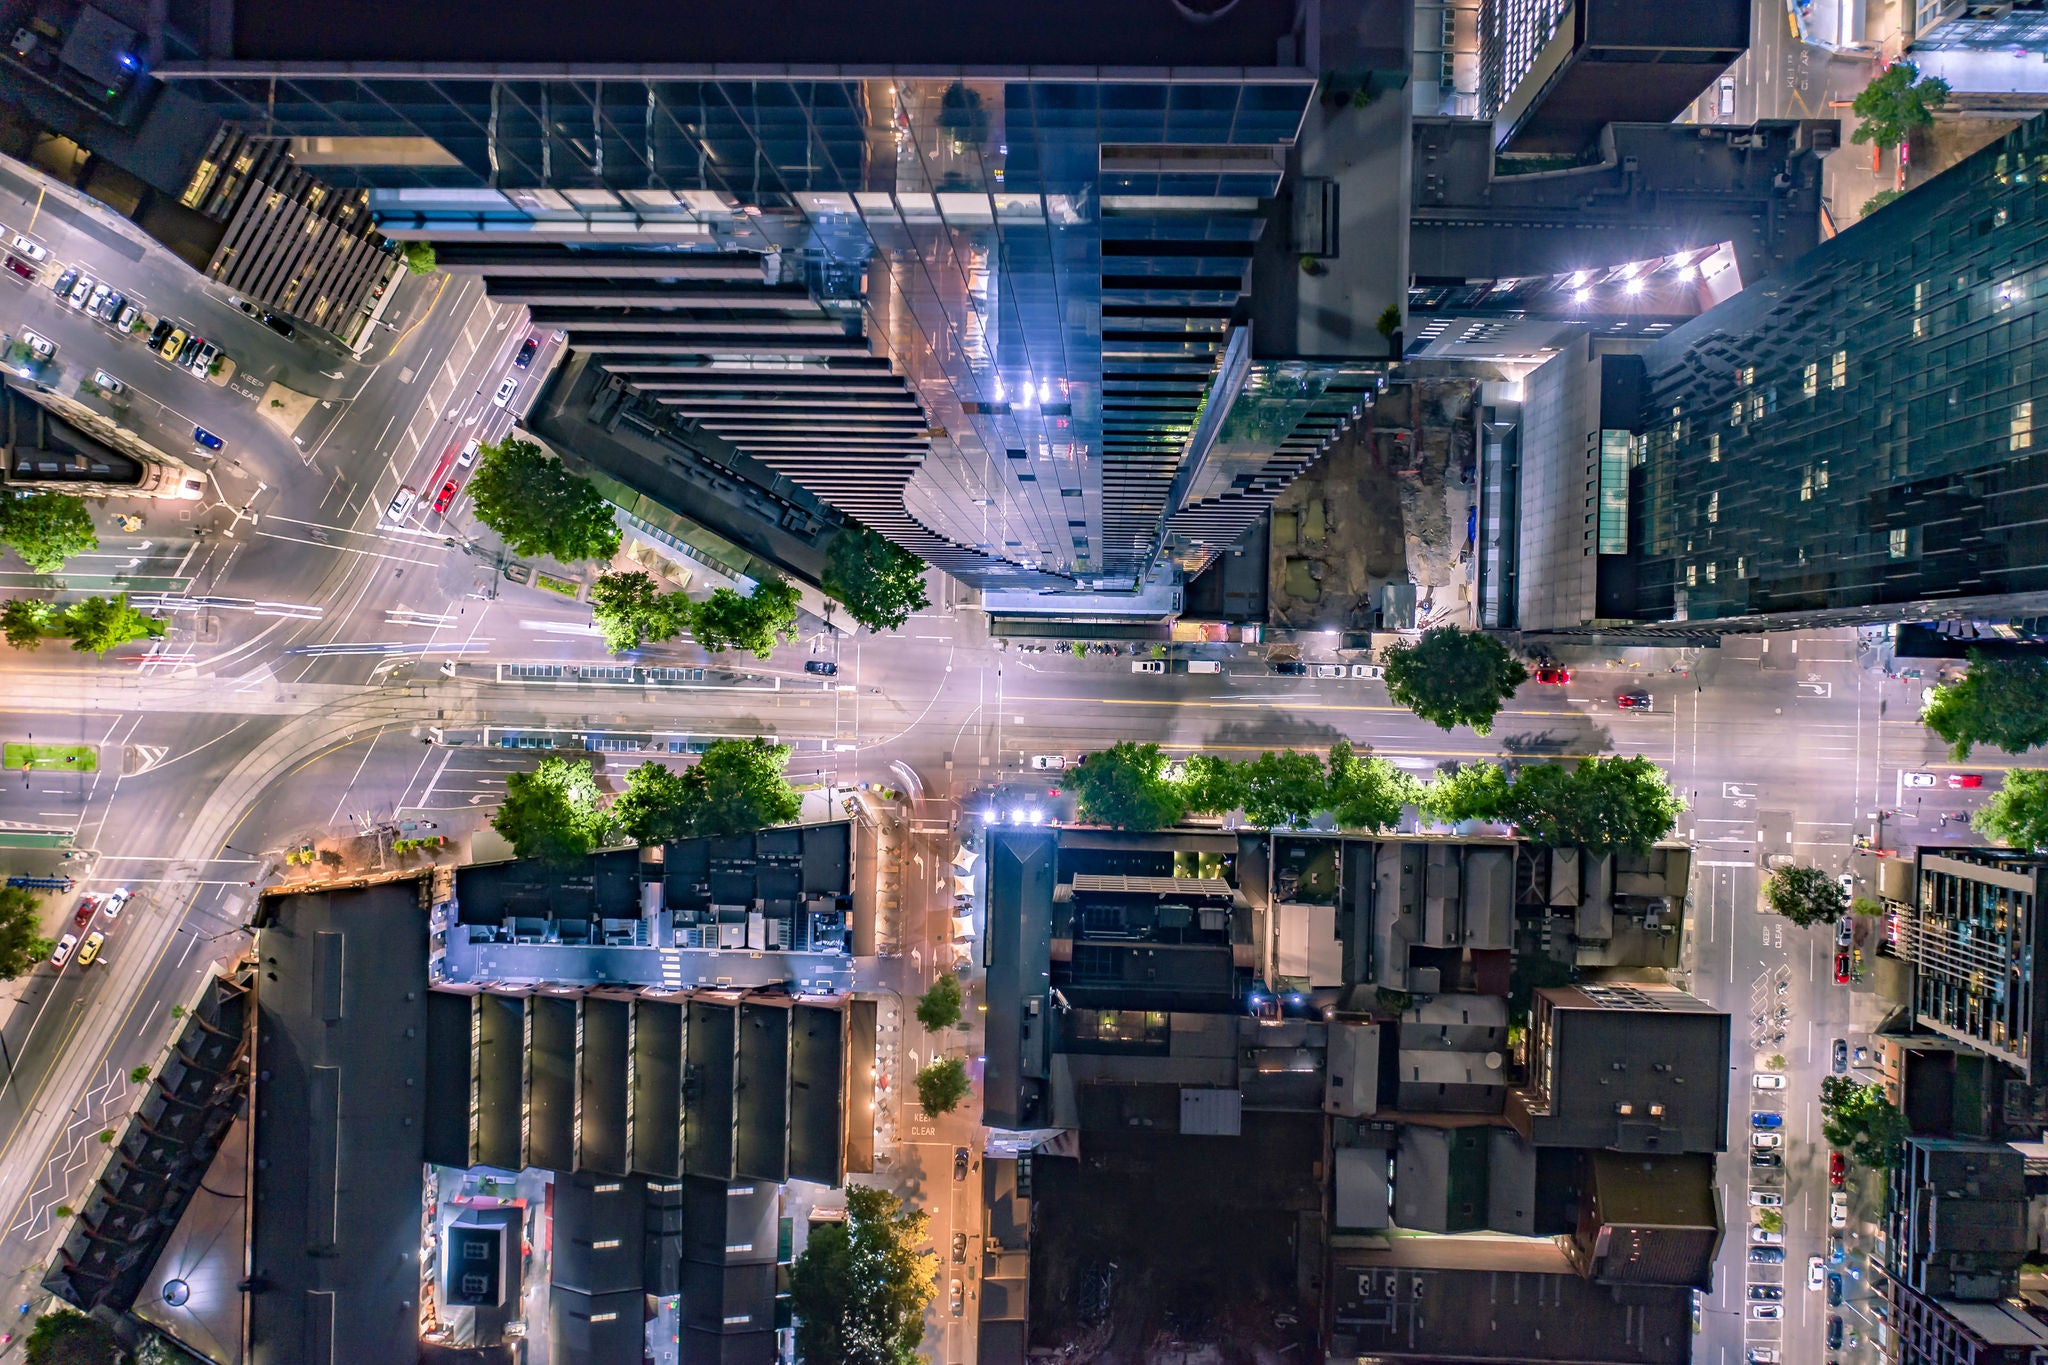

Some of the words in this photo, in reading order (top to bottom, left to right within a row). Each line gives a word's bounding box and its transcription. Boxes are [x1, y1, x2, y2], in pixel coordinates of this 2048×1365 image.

[240, 371, 265, 388] KEEP
[230, 382, 261, 404] CLEAR
[911, 1126, 936, 1136] CLEAR
